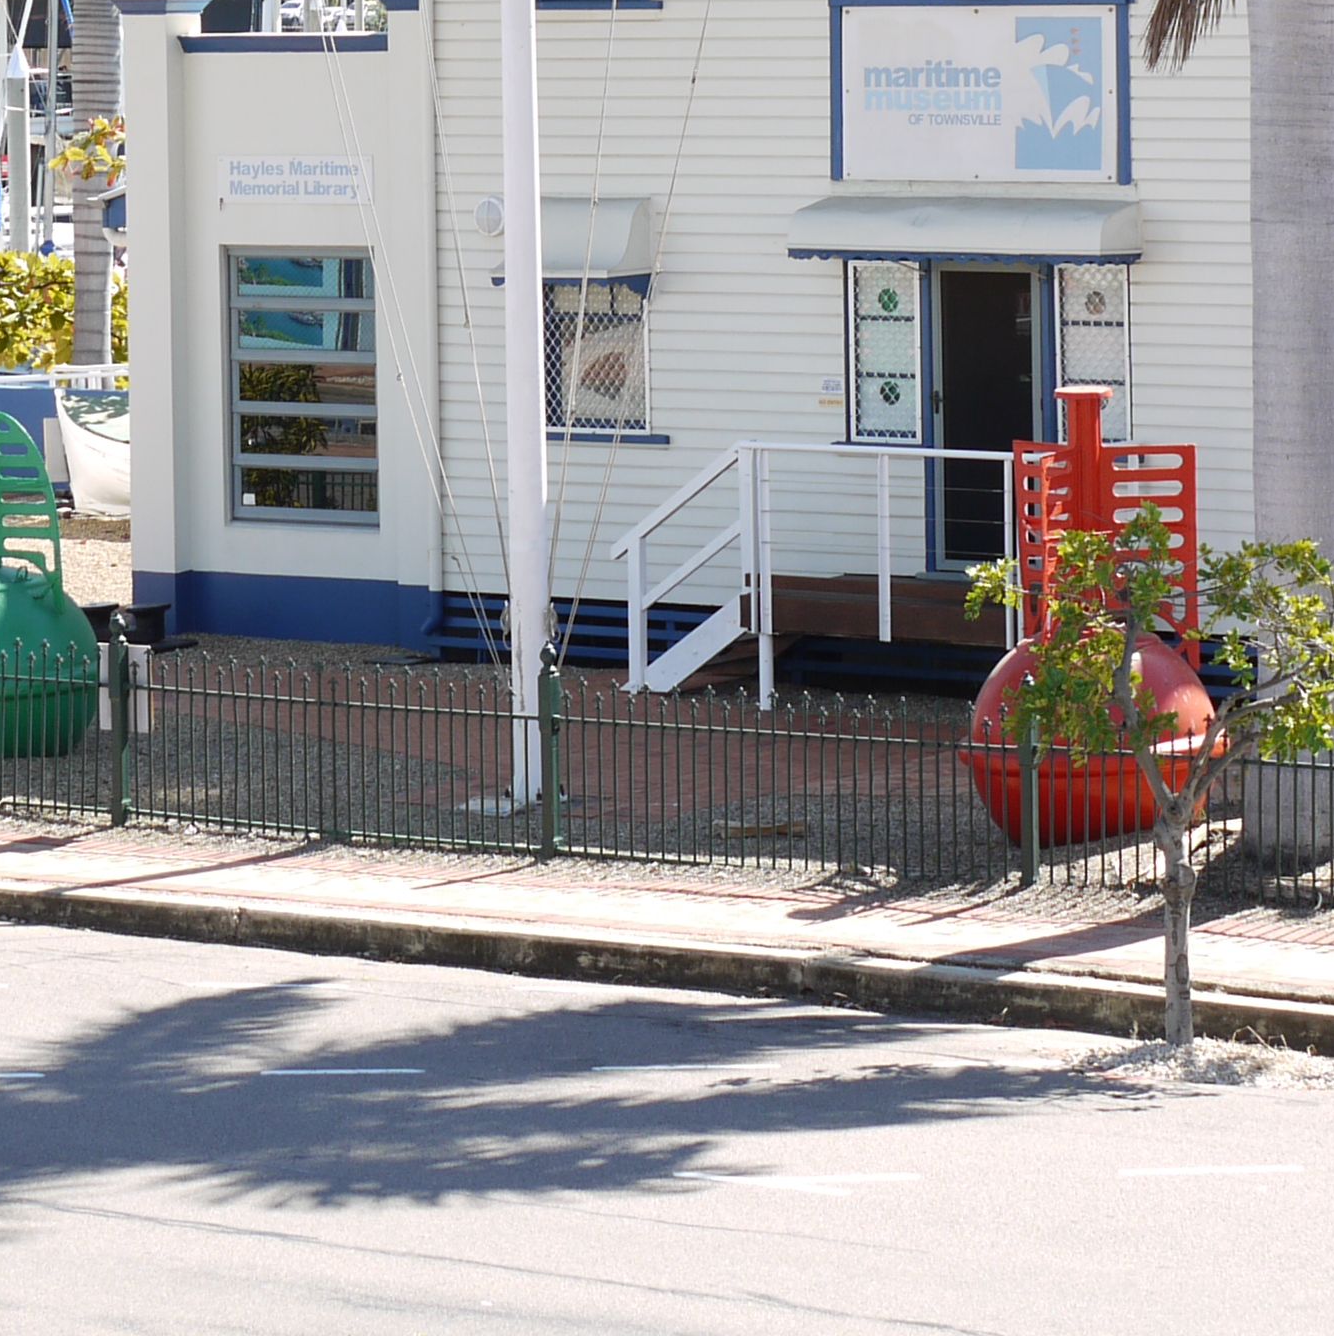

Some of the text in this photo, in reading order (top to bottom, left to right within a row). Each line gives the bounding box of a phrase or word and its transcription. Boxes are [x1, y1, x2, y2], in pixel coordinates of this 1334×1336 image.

[863, 60, 1001, 88] maritime
[863, 90, 1001, 111] museum
[908, 114, 1001, 125] OF TOWNSVILLE
[229, 161, 359, 179] Hayles Maritime
[229, 181, 359, 199] Memorial Library
